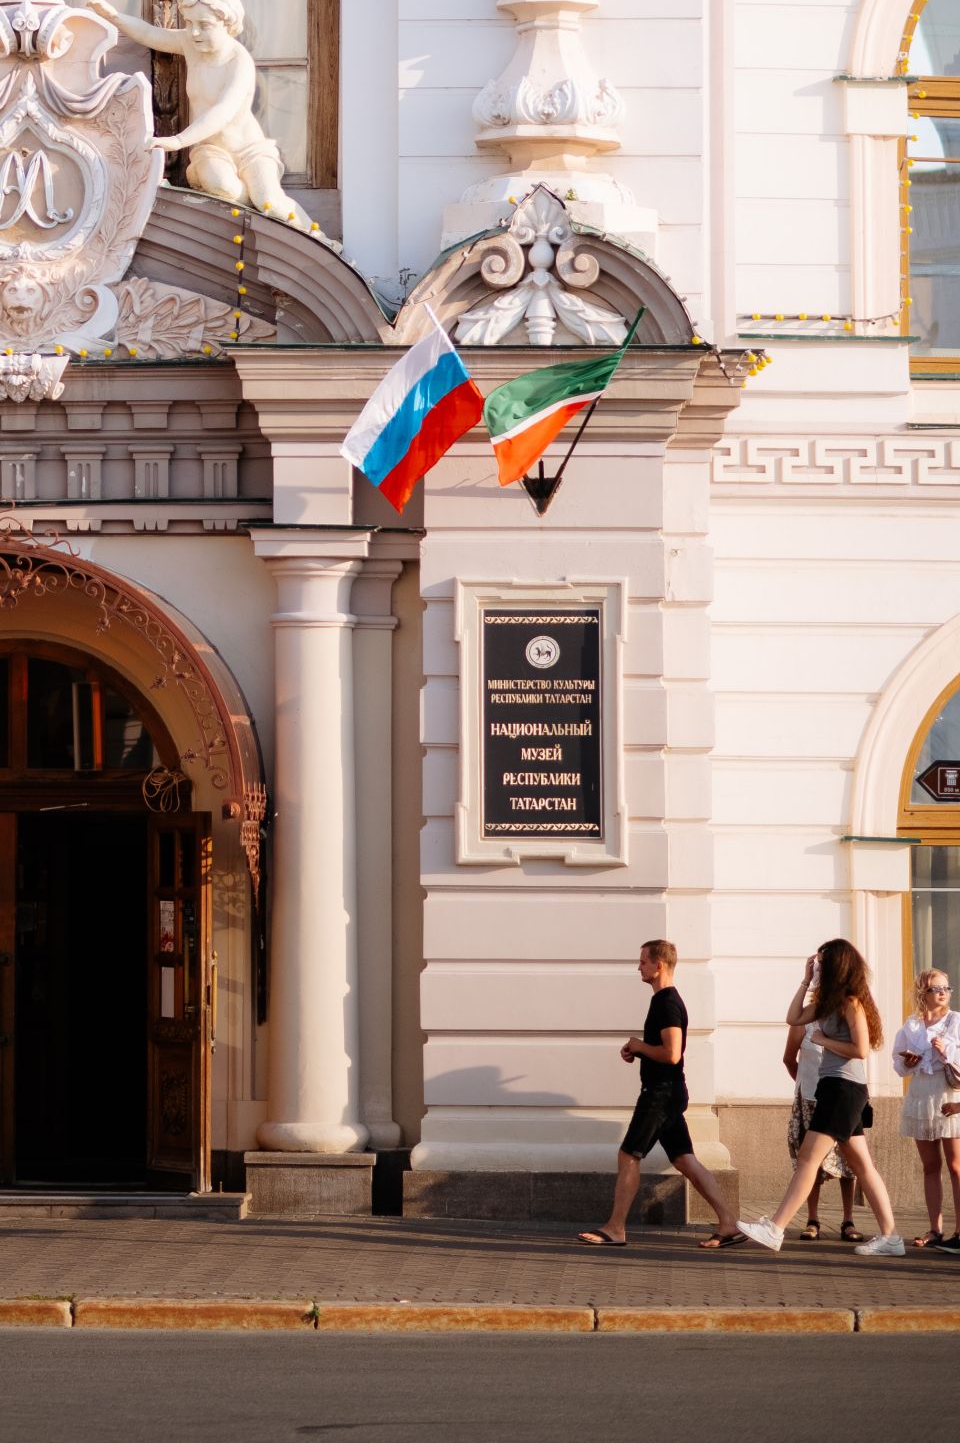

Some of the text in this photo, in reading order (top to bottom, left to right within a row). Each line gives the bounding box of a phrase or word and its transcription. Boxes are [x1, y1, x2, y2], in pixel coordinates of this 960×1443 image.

[487, 679, 595, 690] МИНИСТЕРСТВО КУЛЬТУРЫ
[490, 693, 592, 704] РЕСПУБЛИКИ ТАТАРСТАН
[490, 719, 592, 738] НАЦИОНАЛЬНЫЙ
[520, 743, 562, 761] МУЗЕЙ
[502, 772, 581, 786] РЕСПУБЛИКИ
[509, 797, 577, 811] ТАТАРСТАН
